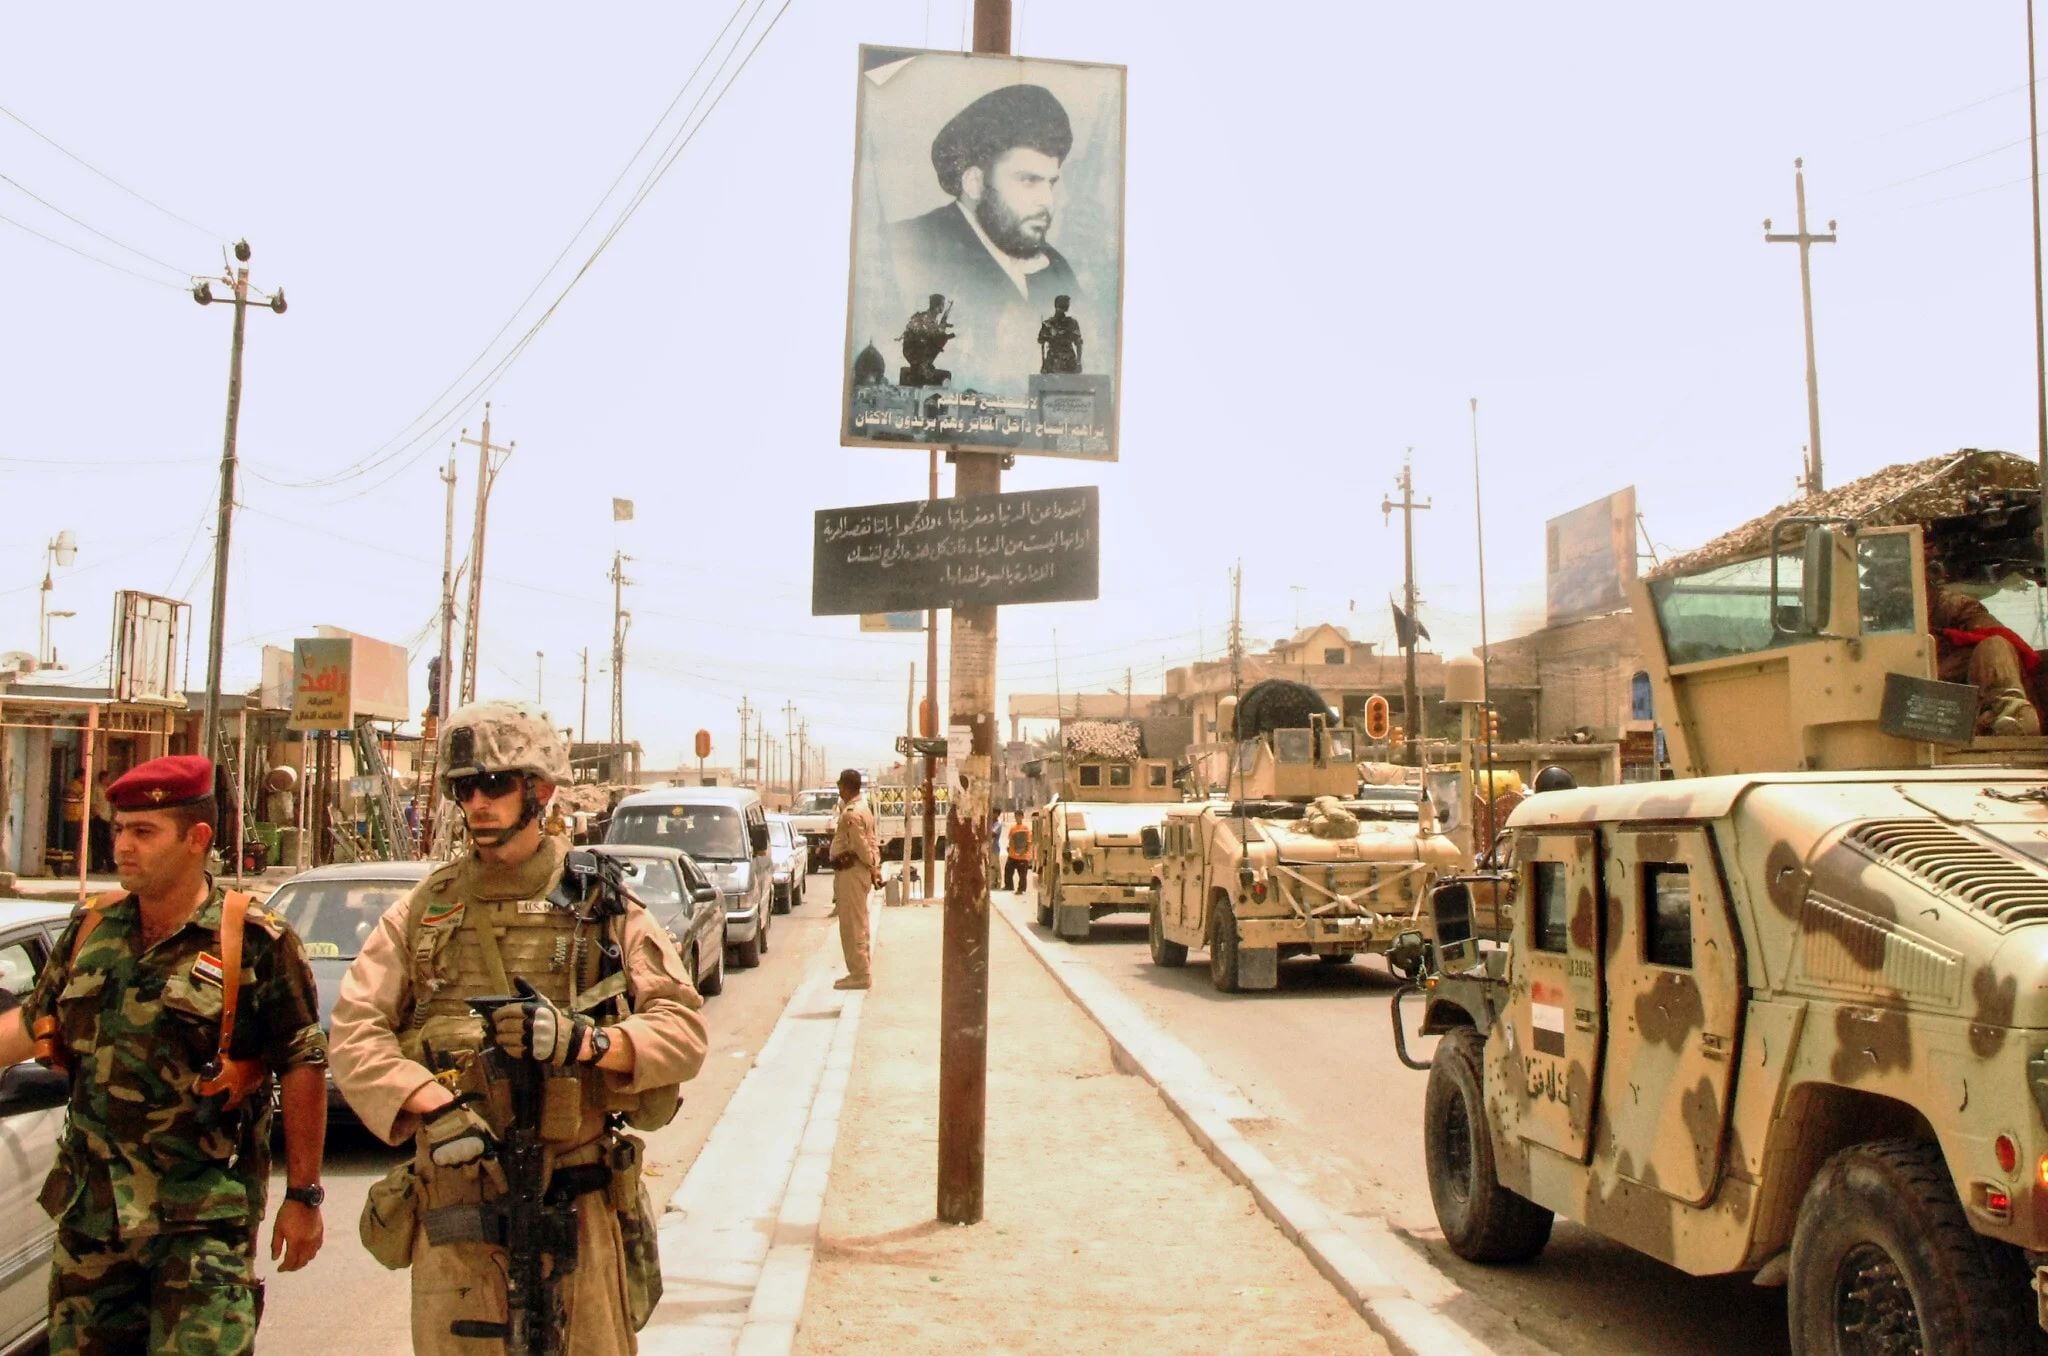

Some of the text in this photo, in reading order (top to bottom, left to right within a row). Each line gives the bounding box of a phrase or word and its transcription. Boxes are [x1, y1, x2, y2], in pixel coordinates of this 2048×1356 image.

[939, 415, 965, 432] وهم
[1001, 418, 1032, 435] داخل
[998, 500, 1031, 528] الدنيا
[1029, 506, 1052, 525] عن
[1003, 539, 1024, 556] من
